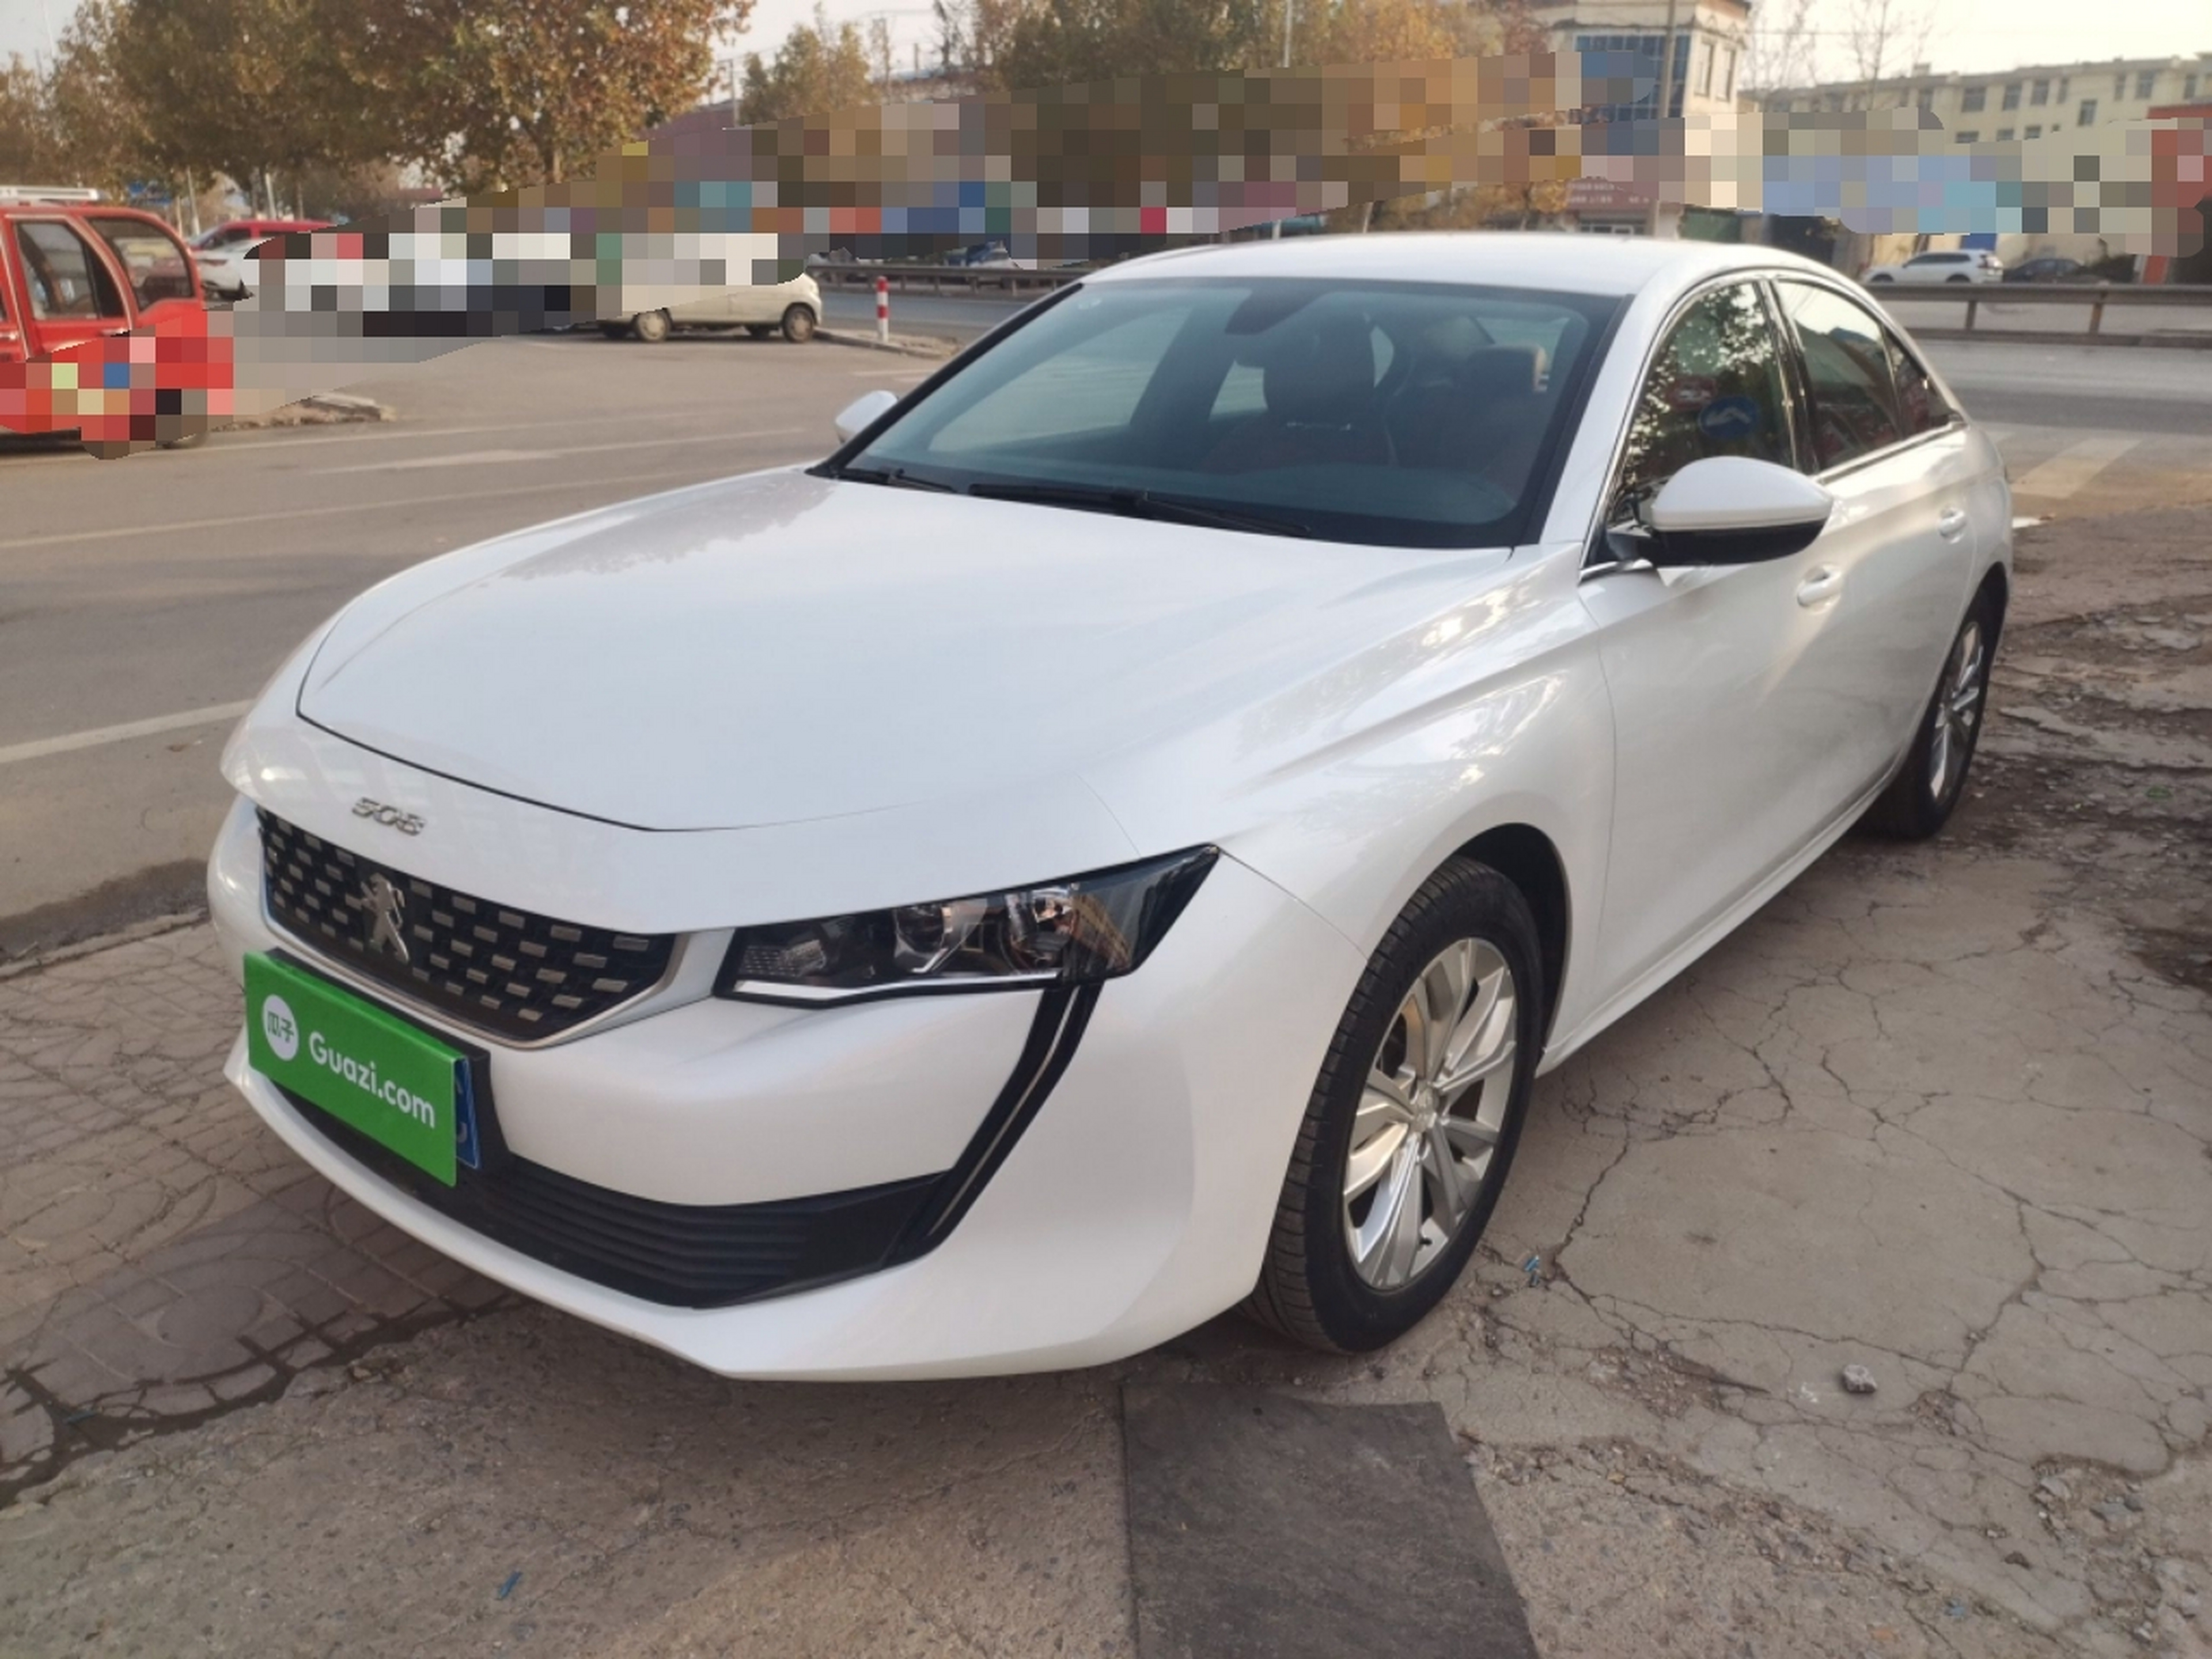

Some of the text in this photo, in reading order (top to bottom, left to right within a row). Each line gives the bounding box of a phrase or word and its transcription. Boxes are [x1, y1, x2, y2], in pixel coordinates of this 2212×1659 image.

[352, 797, 427, 836] 508
[267, 1010, 294, 1043] 瓜子
[309, 1031, 435, 1129] Guazi.com
